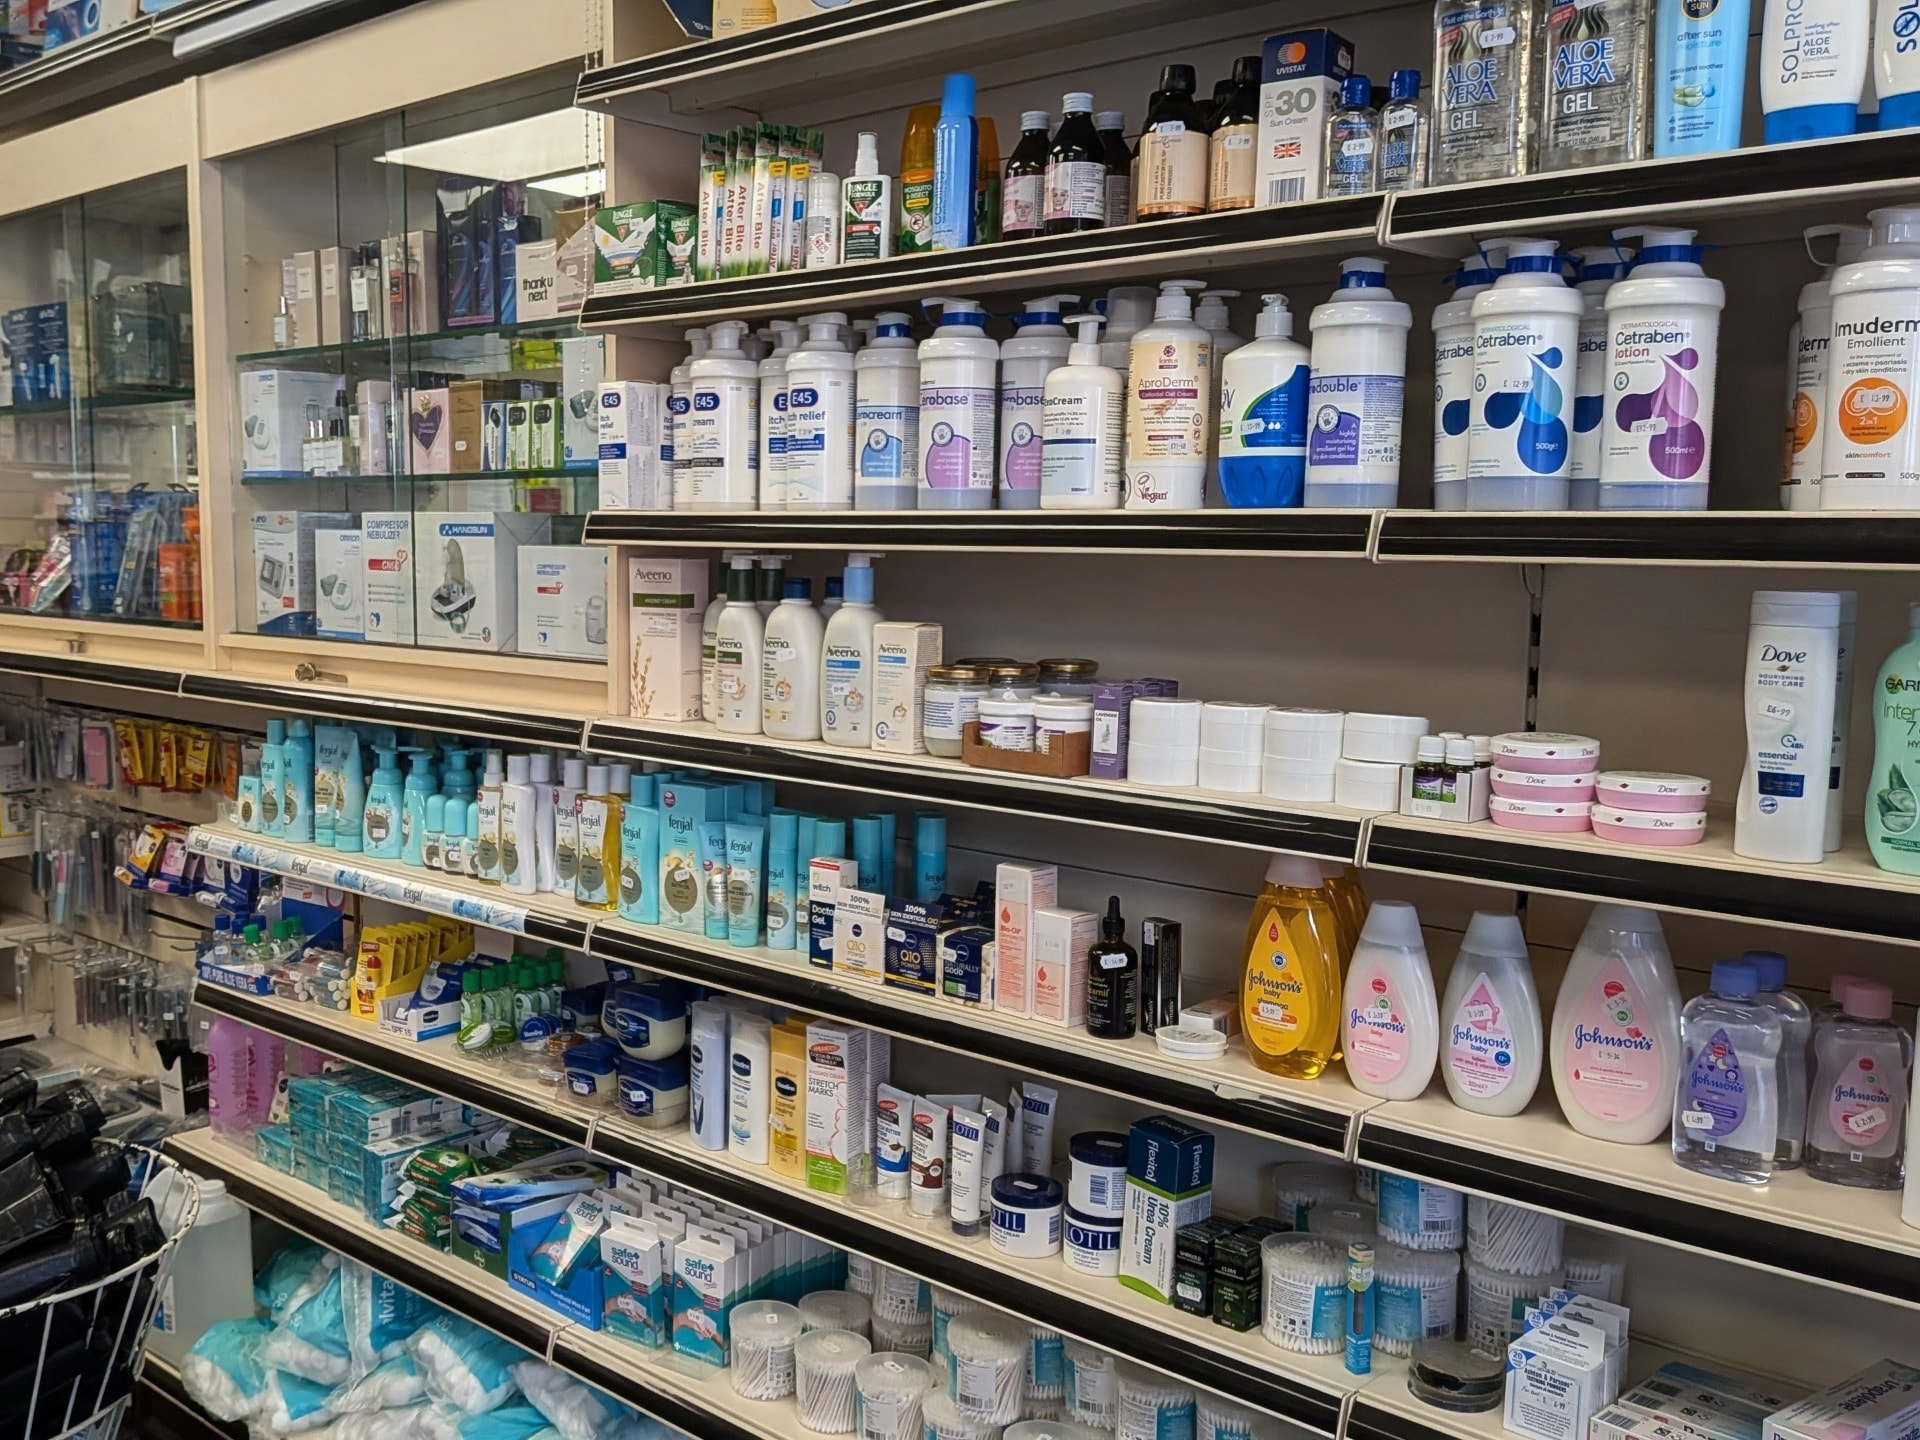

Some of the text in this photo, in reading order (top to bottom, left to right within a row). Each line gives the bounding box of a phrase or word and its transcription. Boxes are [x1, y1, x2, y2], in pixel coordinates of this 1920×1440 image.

[1677, 29, 1722, 42] after sun
[1803, 37, 1831, 48] ALOE
[1555, 37, 1615, 69] ALOE
[1803, 47, 1831, 57] VERA
[1276, 63, 1307, 75] UVISTAT
[1444, 58, 1498, 82] ALOE
[1553, 60, 1615, 91] VERA
[1443, 80, 1498, 107] VERA
[1275, 88, 1317, 116] 30
[1563, 91, 1600, 115] GEL
[1269, 115, 1308, 128] Sun Cream
[1450, 110, 1483, 132] GEL
[1342, 173, 1362, 184] GEL
[848, 182, 878, 193] JUNGLE
[904, 184, 932, 194] MOSQUITO
[728, 188, 736, 224] After
[612, 209, 633, 219] JUNGLE
[736, 185, 747, 252] After Bite
[753, 182, 765, 251] After Bite
[700, 190, 710, 257] After Bite
[522, 277, 554, 291] thank u
[528, 288, 548, 303] next
[1476, 330, 1537, 349] Cetraben
[1615, 330, 1684, 348] Cetraben
[1847, 336, 1906, 350] Emollient
[1614, 346, 1650, 360] lotion
[1875, 358, 1908, 366] psoriasis
[1870, 366, 1908, 374] conditions
[1138, 376, 1195, 390] AproDerm
[604, 395, 618, 406] E45
[695, 395, 714, 408] E45
[792, 391, 813, 405] E45
[799, 411, 826, 421] relief
[635, 567, 673, 582] Aveeno
[826, 645, 862, 658] Aveeno
[878, 643, 907, 655] Aveeno
[1761, 644, 1808, 664] Dove
[1782, 680, 1805, 688] CARE
[1766, 704, 1792, 718] £6-99
[1906, 721, 1915, 736] 7
[1501, 745, 1518, 756] Dove
[1758, 751, 1798, 762] essential
[1525, 775, 1547, 786] Dove
[1657, 783, 1679, 794] Dove
[1508, 802, 1527, 813] Dove
[669, 814, 694, 834] fenjal
[1652, 818, 1675, 829] Dove
[730, 840, 753, 853] fenjal
[812, 883, 831, 893] witch
[850, 894, 870, 905] 100%
[904, 904, 926, 915] 100%
[846, 939, 866, 951] Q10
[900, 950, 921, 962] Q10
[900, 962, 921, 970] POWER
[944, 966, 964, 976] GOOD
[1248, 968, 1303, 994] Johnson's
[1263, 988, 1281, 999] baby
[391, 1024, 412, 1037] SPF 15
[1453, 1023, 1512, 1050] Johnson's
[1574, 1024, 1654, 1051] Johnson's
[1470, 1042, 1489, 1054] baby
[808, 1077, 839, 1091] STRETCH
[1692, 1070, 1744, 1094] Johnson's
[808, 1086, 834, 1098] MARKS
[1835, 1084, 1891, 1103] Johnson's
[1144, 1138, 1159, 1184] Flexitol
[1190, 1143, 1203, 1187] Flexitol
[574, 1207, 596, 1222] sound
[579, 1201, 595, 1214] safe
[1157, 1202, 1170, 1229] 10%
[1065, 1222, 1118, 1250] LOTIL
[1143, 1196, 1158, 1265] Urea Cream
[611, 1246, 634, 1260] safe
[611, 1255, 639, 1271] sound
[684, 1257, 708, 1272] safe
[684, 1266, 713, 1283] sound
[1531, 1313, 1541, 1321] 20
[1513, 1351, 1523, 1360] 20
[1523, 1367, 1543, 1380] Ashton
[1549, 1375, 1570, 1389] Parsons
